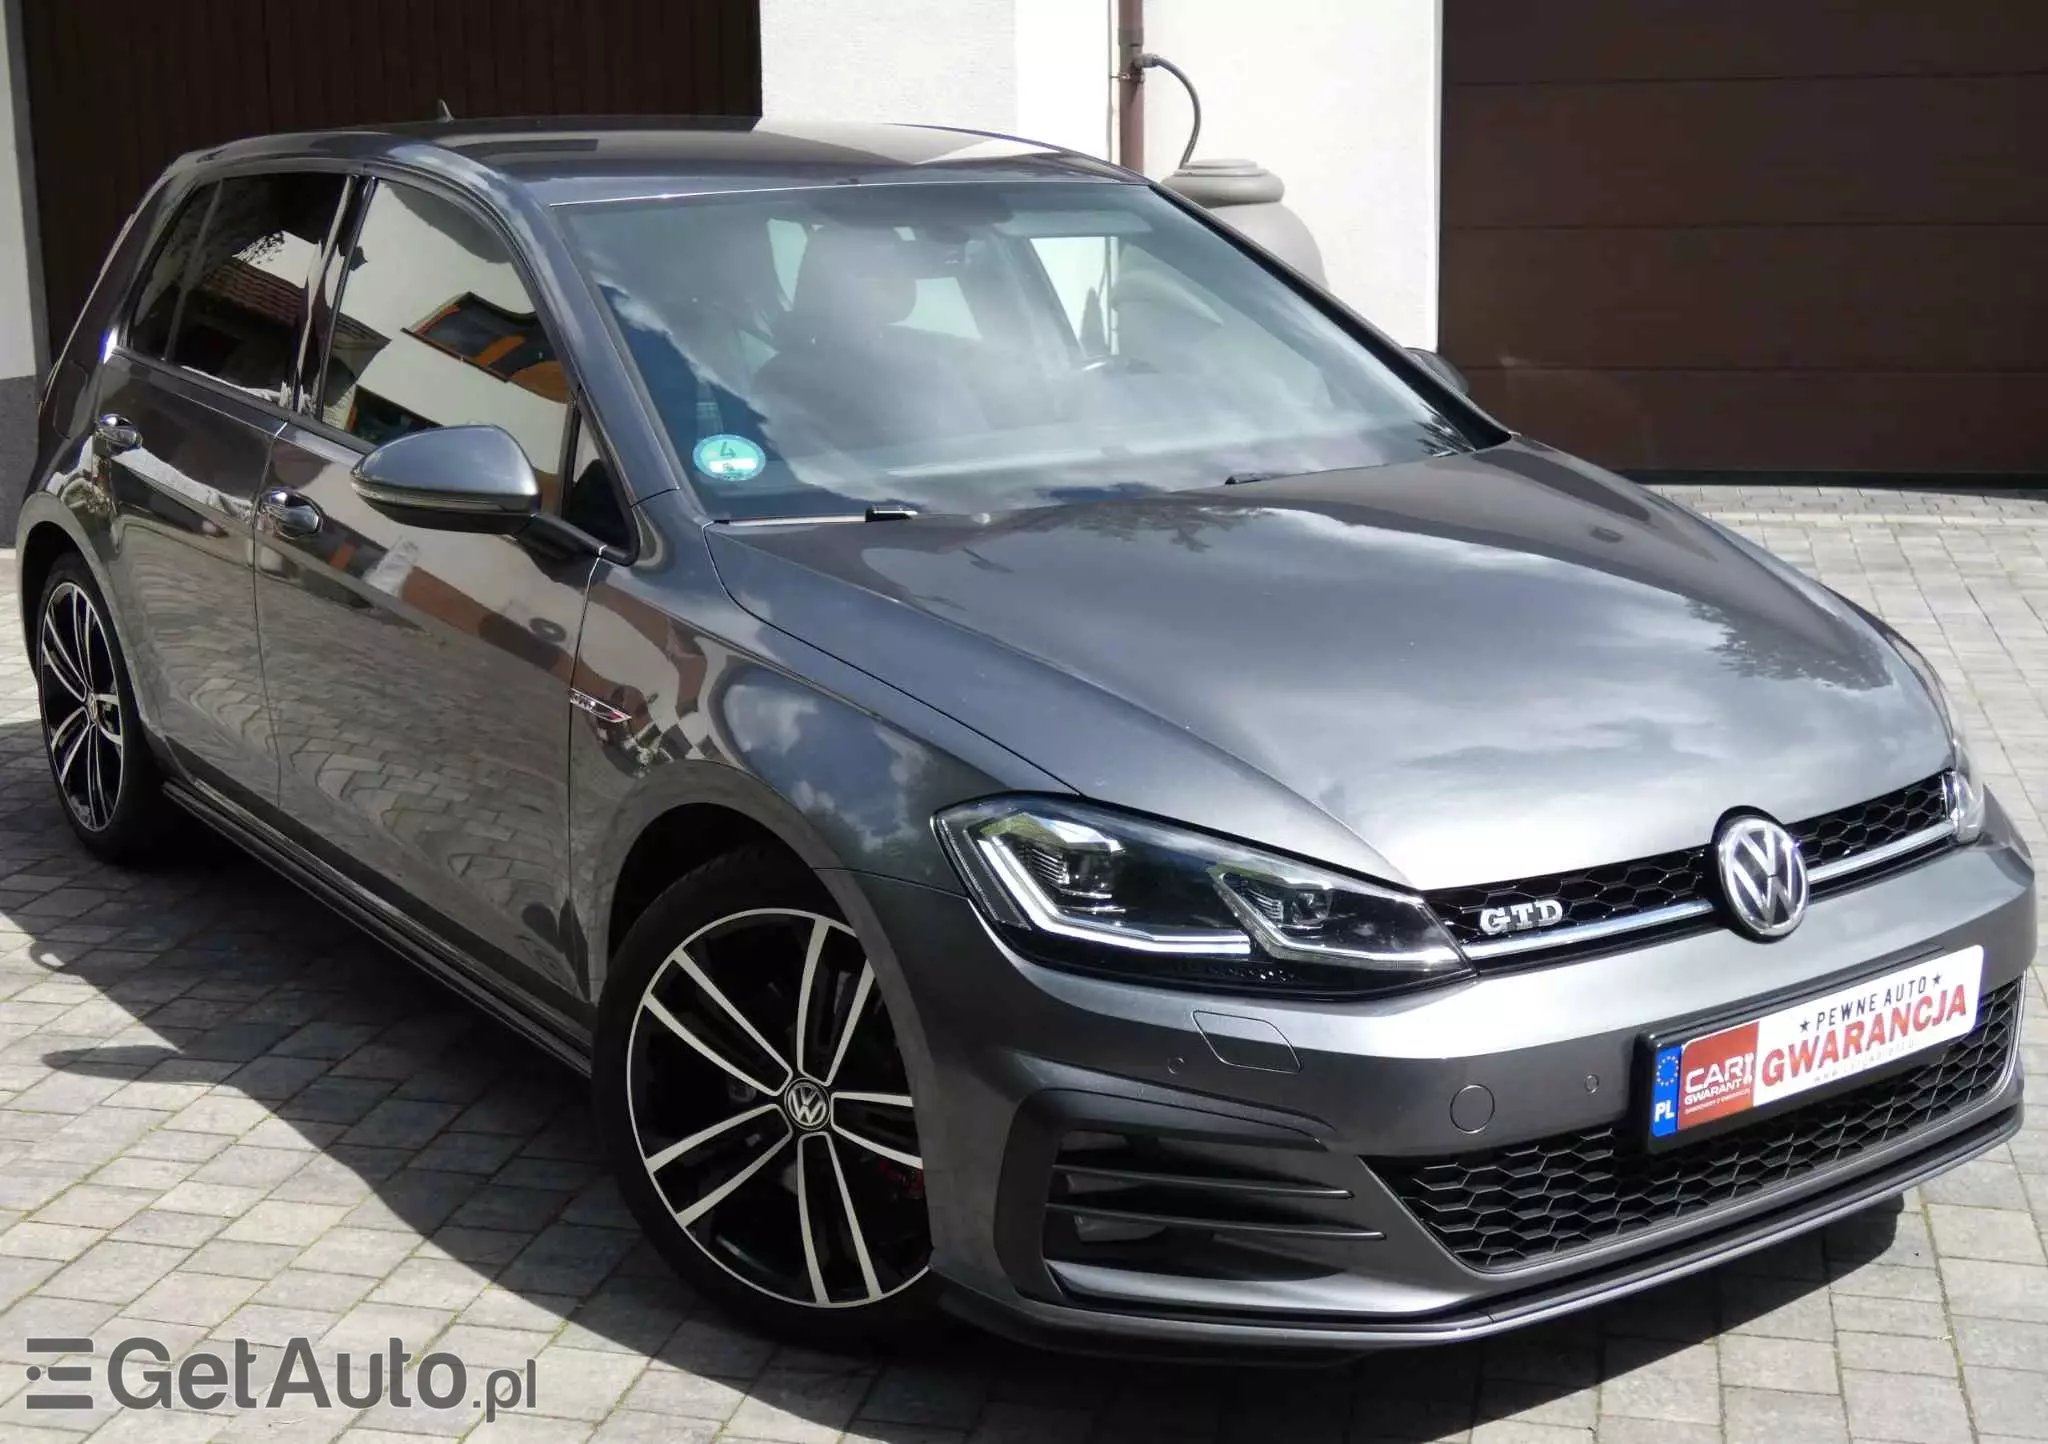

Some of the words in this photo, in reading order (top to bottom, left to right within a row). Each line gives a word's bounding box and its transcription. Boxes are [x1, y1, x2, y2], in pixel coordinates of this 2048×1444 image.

[1479, 899, 1564, 936] GTD
[1816, 993, 1878, 1031] PEWNE
[1884, 975, 1928, 1007] AUTO
[1761, 983, 1967, 1088] GWARANCJA
[1654, 1099, 1675, 1123] PL
